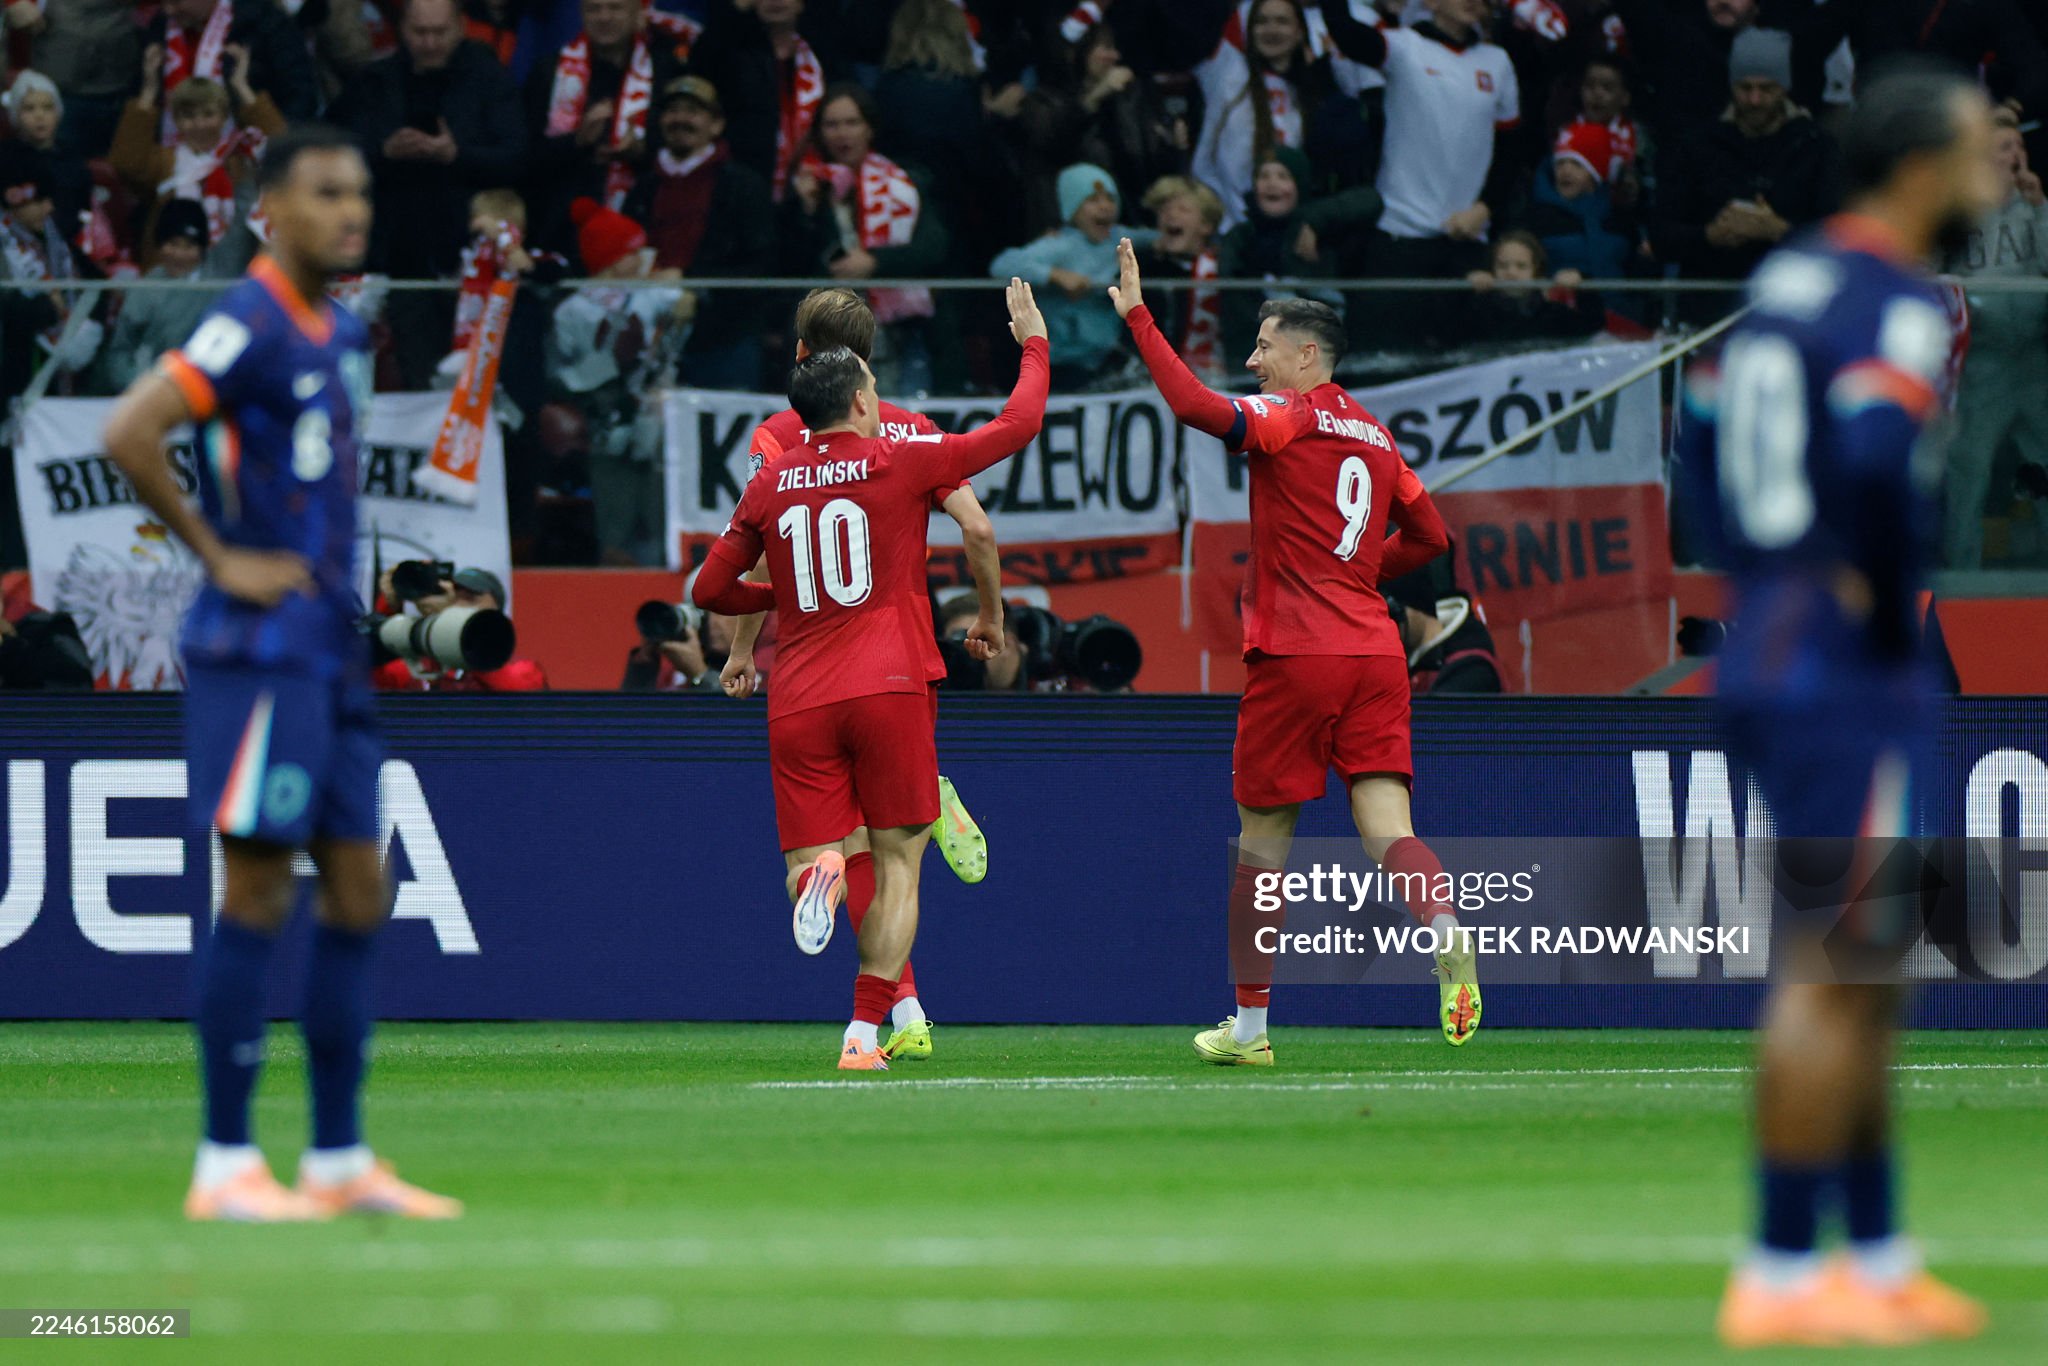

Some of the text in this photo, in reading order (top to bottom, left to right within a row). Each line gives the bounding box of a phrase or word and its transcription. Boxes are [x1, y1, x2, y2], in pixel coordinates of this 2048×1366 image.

[776, 459, 868, 493] ZIELIŃSKI
[1333, 455, 1372, 562] 9
[778, 498, 873, 613] 10
[1465, 517, 1634, 595] RNIE
